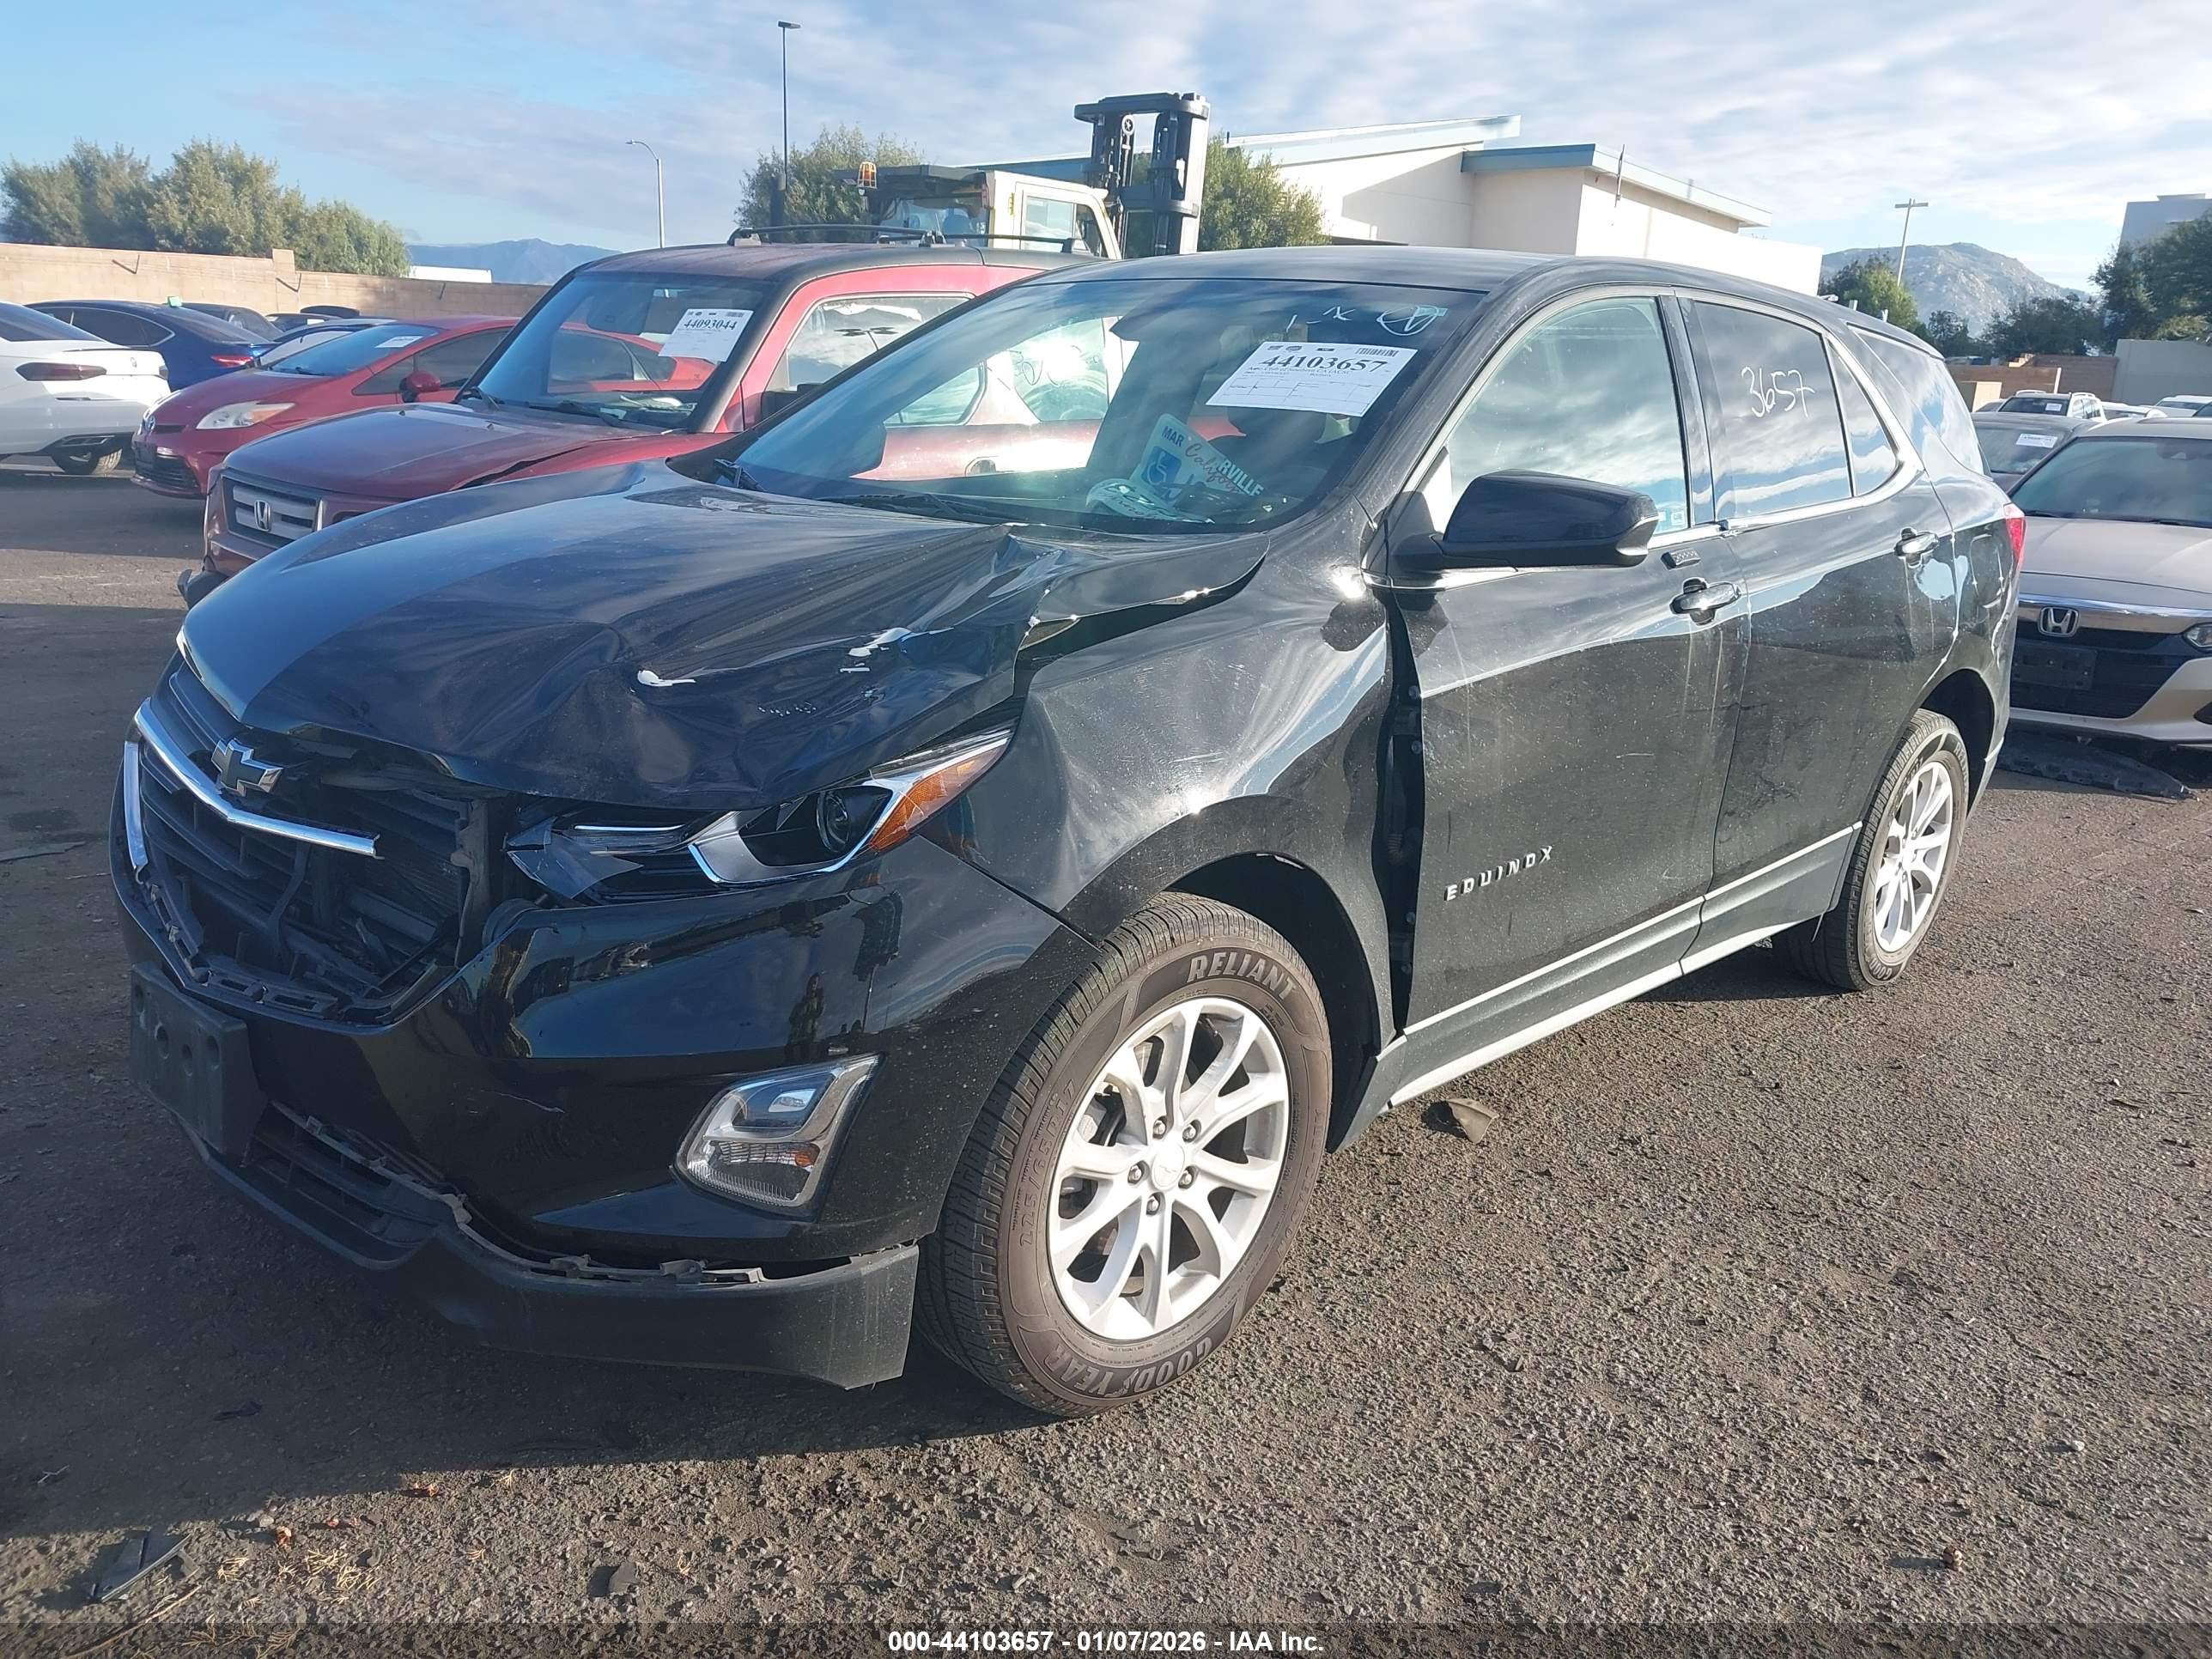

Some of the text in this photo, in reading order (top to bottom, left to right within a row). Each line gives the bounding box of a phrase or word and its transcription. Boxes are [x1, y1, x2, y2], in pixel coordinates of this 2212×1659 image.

[684, 319, 738, 331] 44093044
[1257, 355, 1389, 373] 44103657
[1741, 367, 1815, 418] 3657
[1161, 425, 1185, 447] MAR
[1185, 441, 1238, 494] Califor
[1444, 845, 1553, 901] EQUINOX
[1187, 951, 1297, 1000] RELIANT
[1019, 1079, 1077, 1247] 225/65R17
